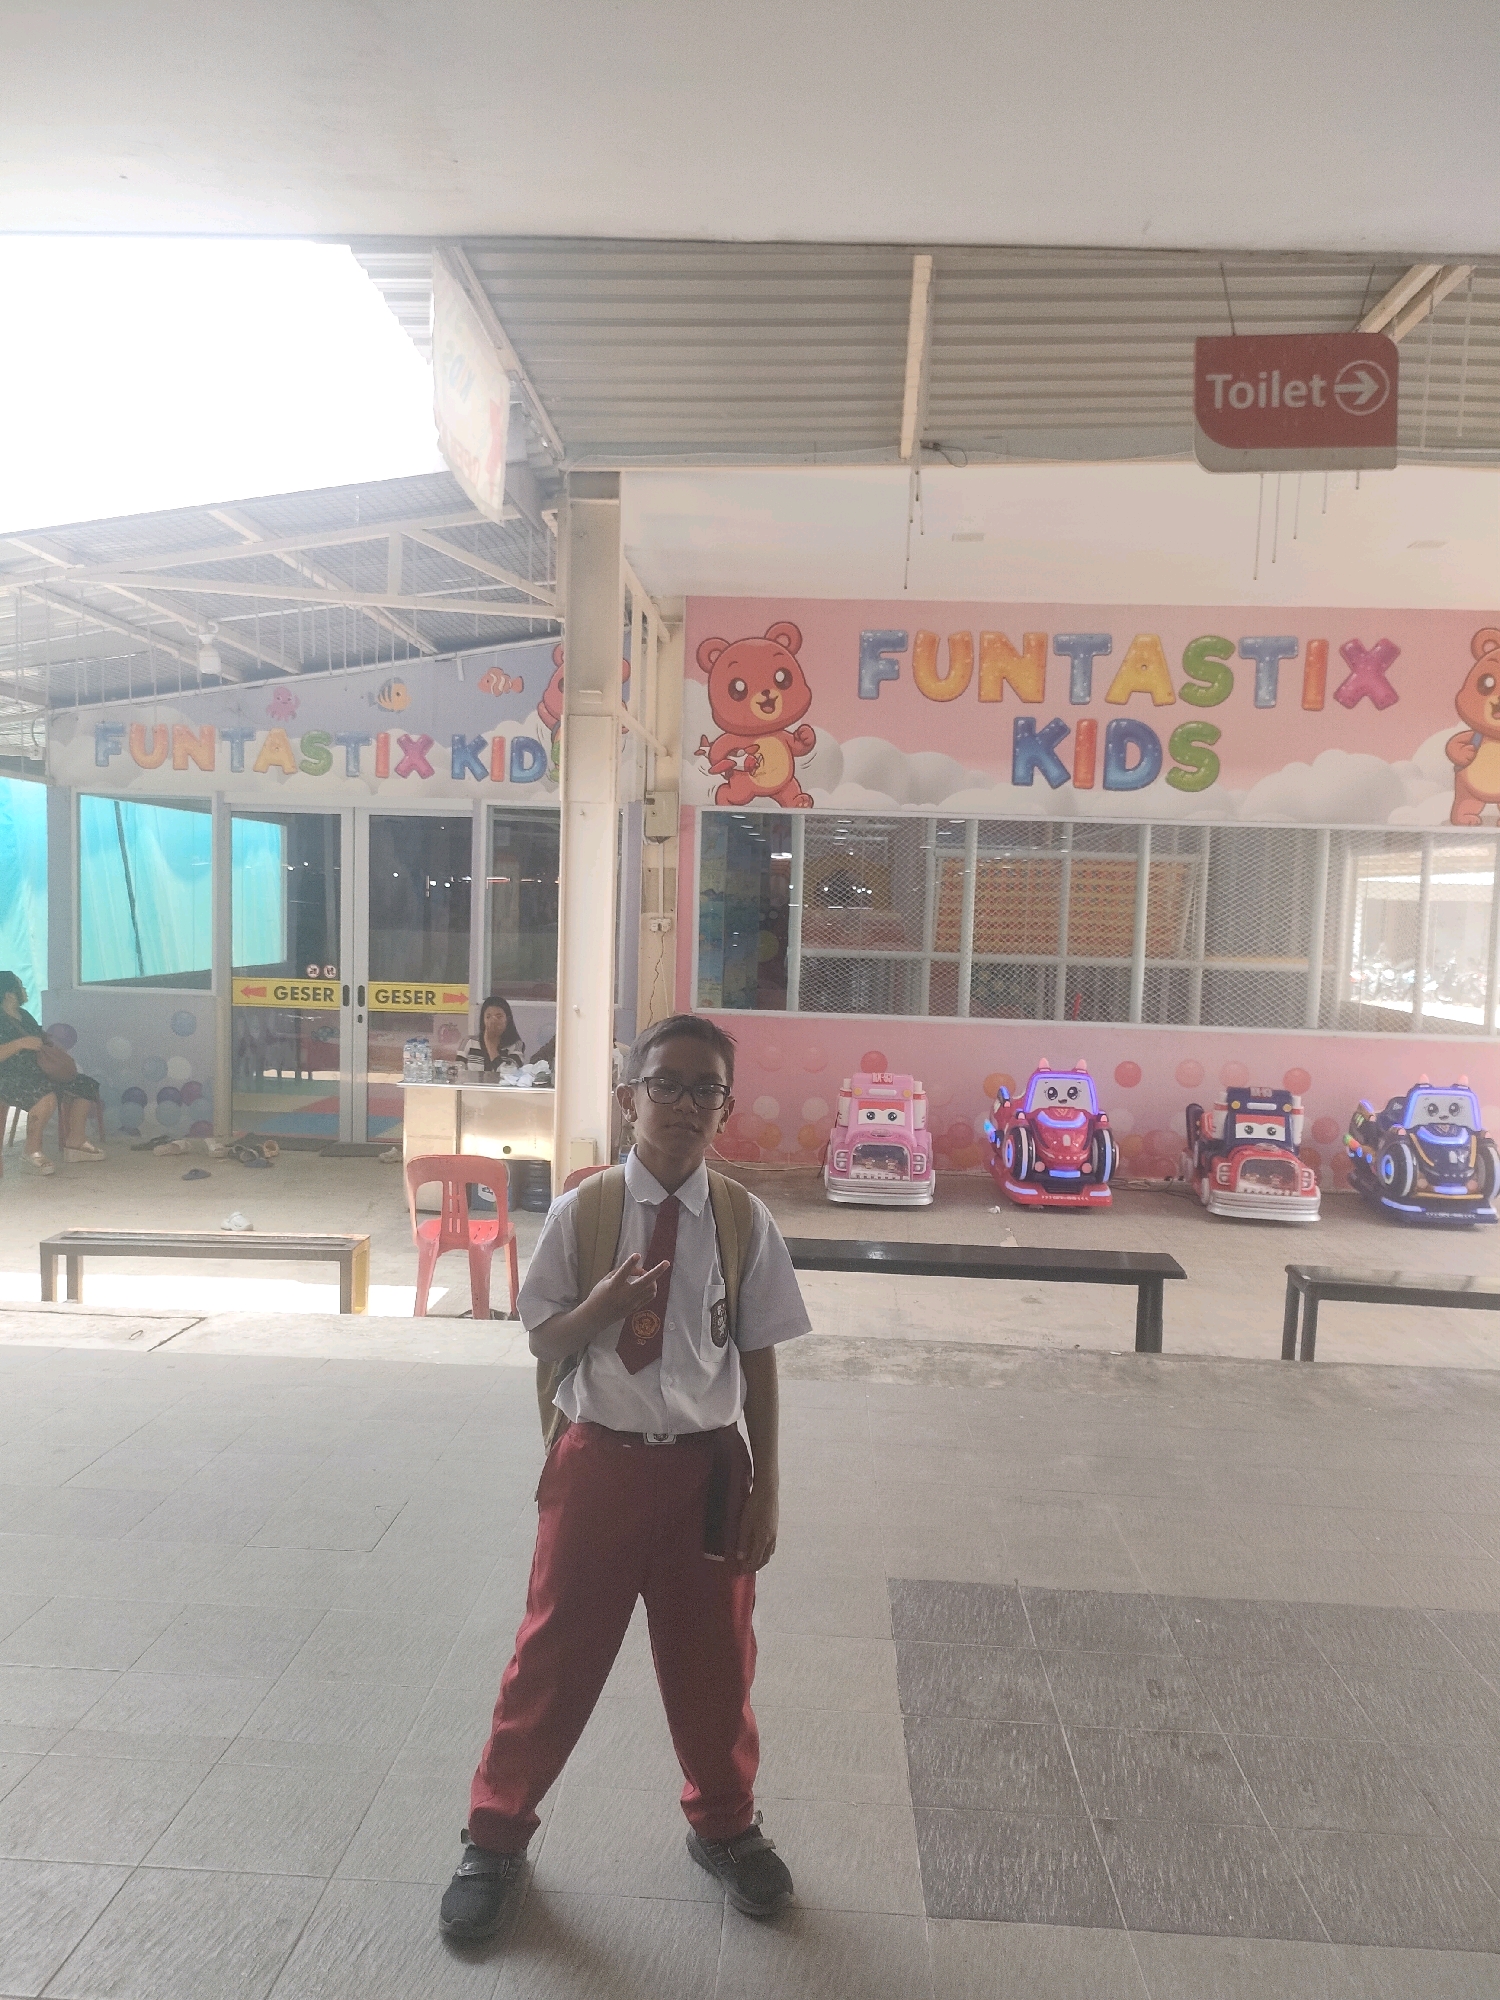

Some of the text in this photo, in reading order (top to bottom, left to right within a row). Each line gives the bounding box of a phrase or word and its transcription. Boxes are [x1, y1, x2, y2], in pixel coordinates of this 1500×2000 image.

[1205, 370, 1327, 409] Toilet
[857, 629, 1401, 711] FUNTASTIX
[94, 721, 559, 784] FUNTASTIX KID
[1012, 716, 1222, 792] KIDS
[273, 985, 334, 1002] GESER
[375, 988, 436, 1006] GESER
